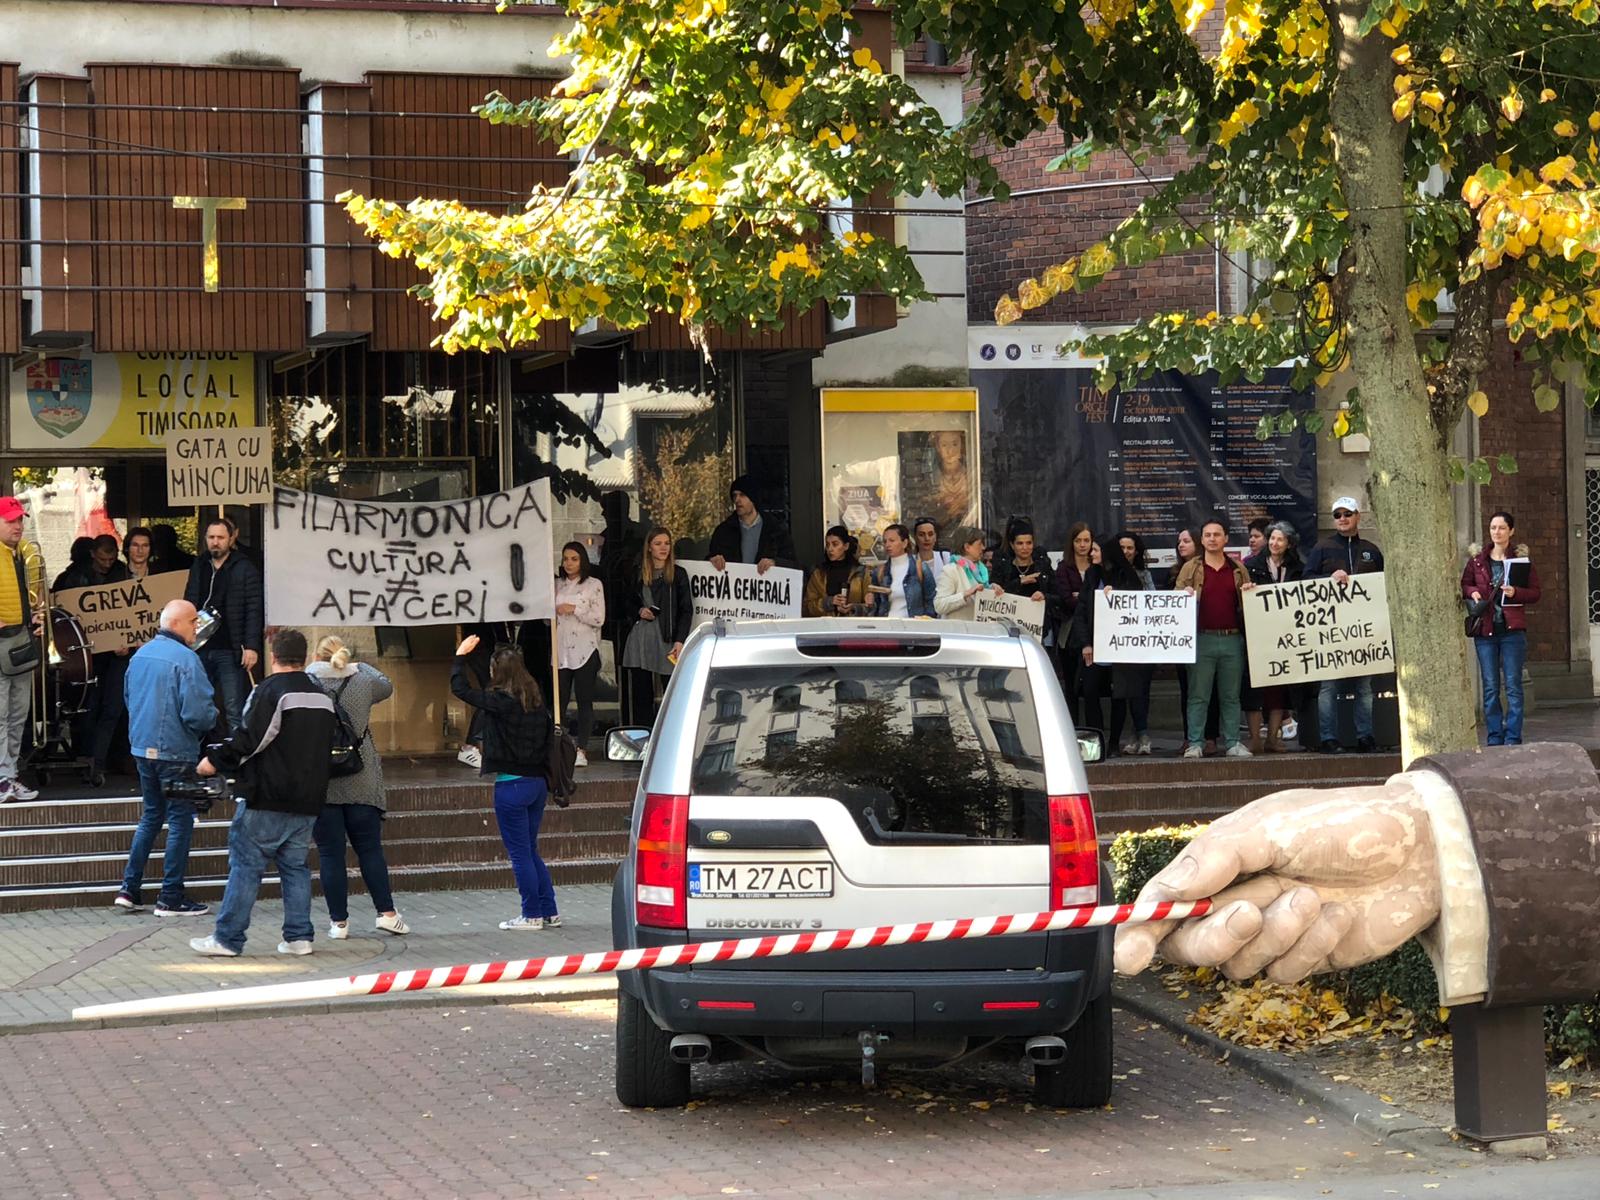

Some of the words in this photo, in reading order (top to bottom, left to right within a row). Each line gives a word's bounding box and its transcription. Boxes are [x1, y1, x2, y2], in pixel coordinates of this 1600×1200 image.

[137, 373, 240, 398] LOCAL
[176, 438, 227, 459] GATA
[237, 436, 261, 457] CU
[272, 486, 547, 538] FILARMONICA
[327, 541, 472, 577] CULTURĂ
[78, 578, 152, 613] GREVĂ
[691, 571, 731, 600] GREVĂ
[733, 578, 791, 606] GENERALĂ
[1105, 593, 1138, 611] VREM
[1144, 593, 1192, 611] RESPECT
[1294, 605, 1337, 629] 2021
[1276, 632, 1308, 650] ARE
[1268, 660, 1291, 677] DE
[702, 867, 736, 891] TM
[747, 867, 774, 890] 27
[777, 867, 828, 890] ACT
[705, 918, 804, 929] DISCOVERY
[811, 918, 823, 929] 3
